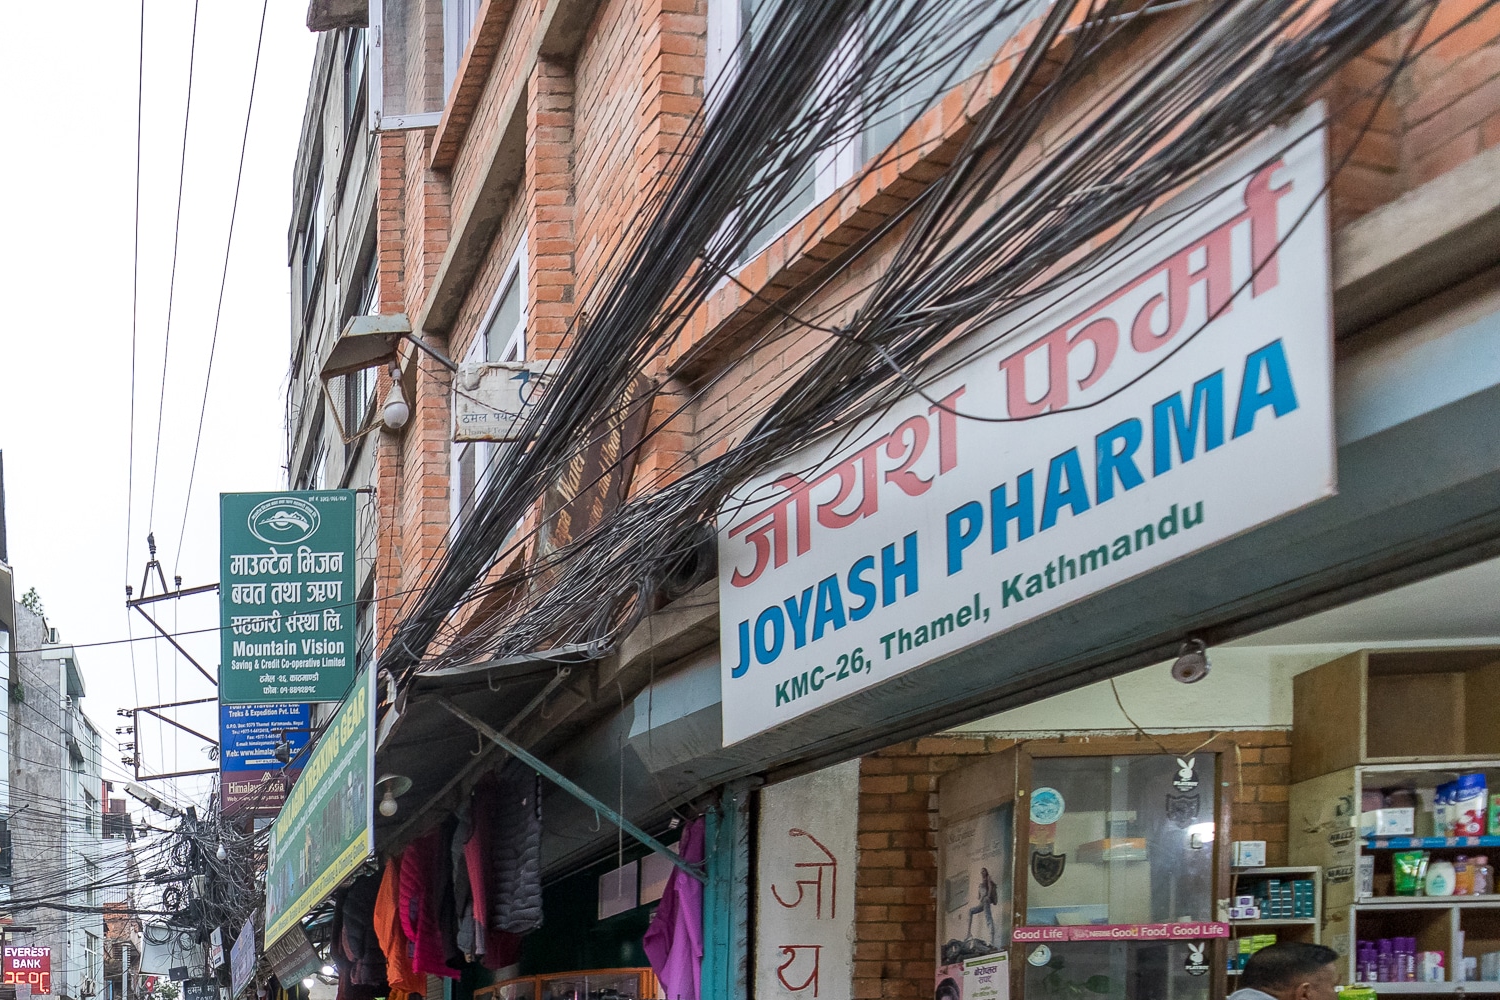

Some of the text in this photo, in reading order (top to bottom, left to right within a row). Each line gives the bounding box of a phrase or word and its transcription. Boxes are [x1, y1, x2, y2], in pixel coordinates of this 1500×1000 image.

[731, 337, 1299, 680] JOYASH PHARMA
[230, 545, 344, 575] माउन्टेन भिजन
[231, 580, 343, 606] बचत तथा ऋण
[774, 500, 1206, 708] KMC-26, Thamel, Kathmandu
[231, 610, 282, 635] सहकारी
[285, 610, 320, 634] संस्था
[233, 638, 345, 657] Mountain Vision
[231, 656, 346, 672] Saving & Credit Co-operative Limited
[229, 710, 244, 718] Treks
[245, 709, 250, 717] &
[250, 709, 278, 717] Expedition
[304, 725, 340, 800] TREKKING
[340, 686, 366, 748] GEAR
[1013, 923, 1224, 940] Good Life Good Food, Good Life
[4, 947, 51, 969] EVEREST BANK
